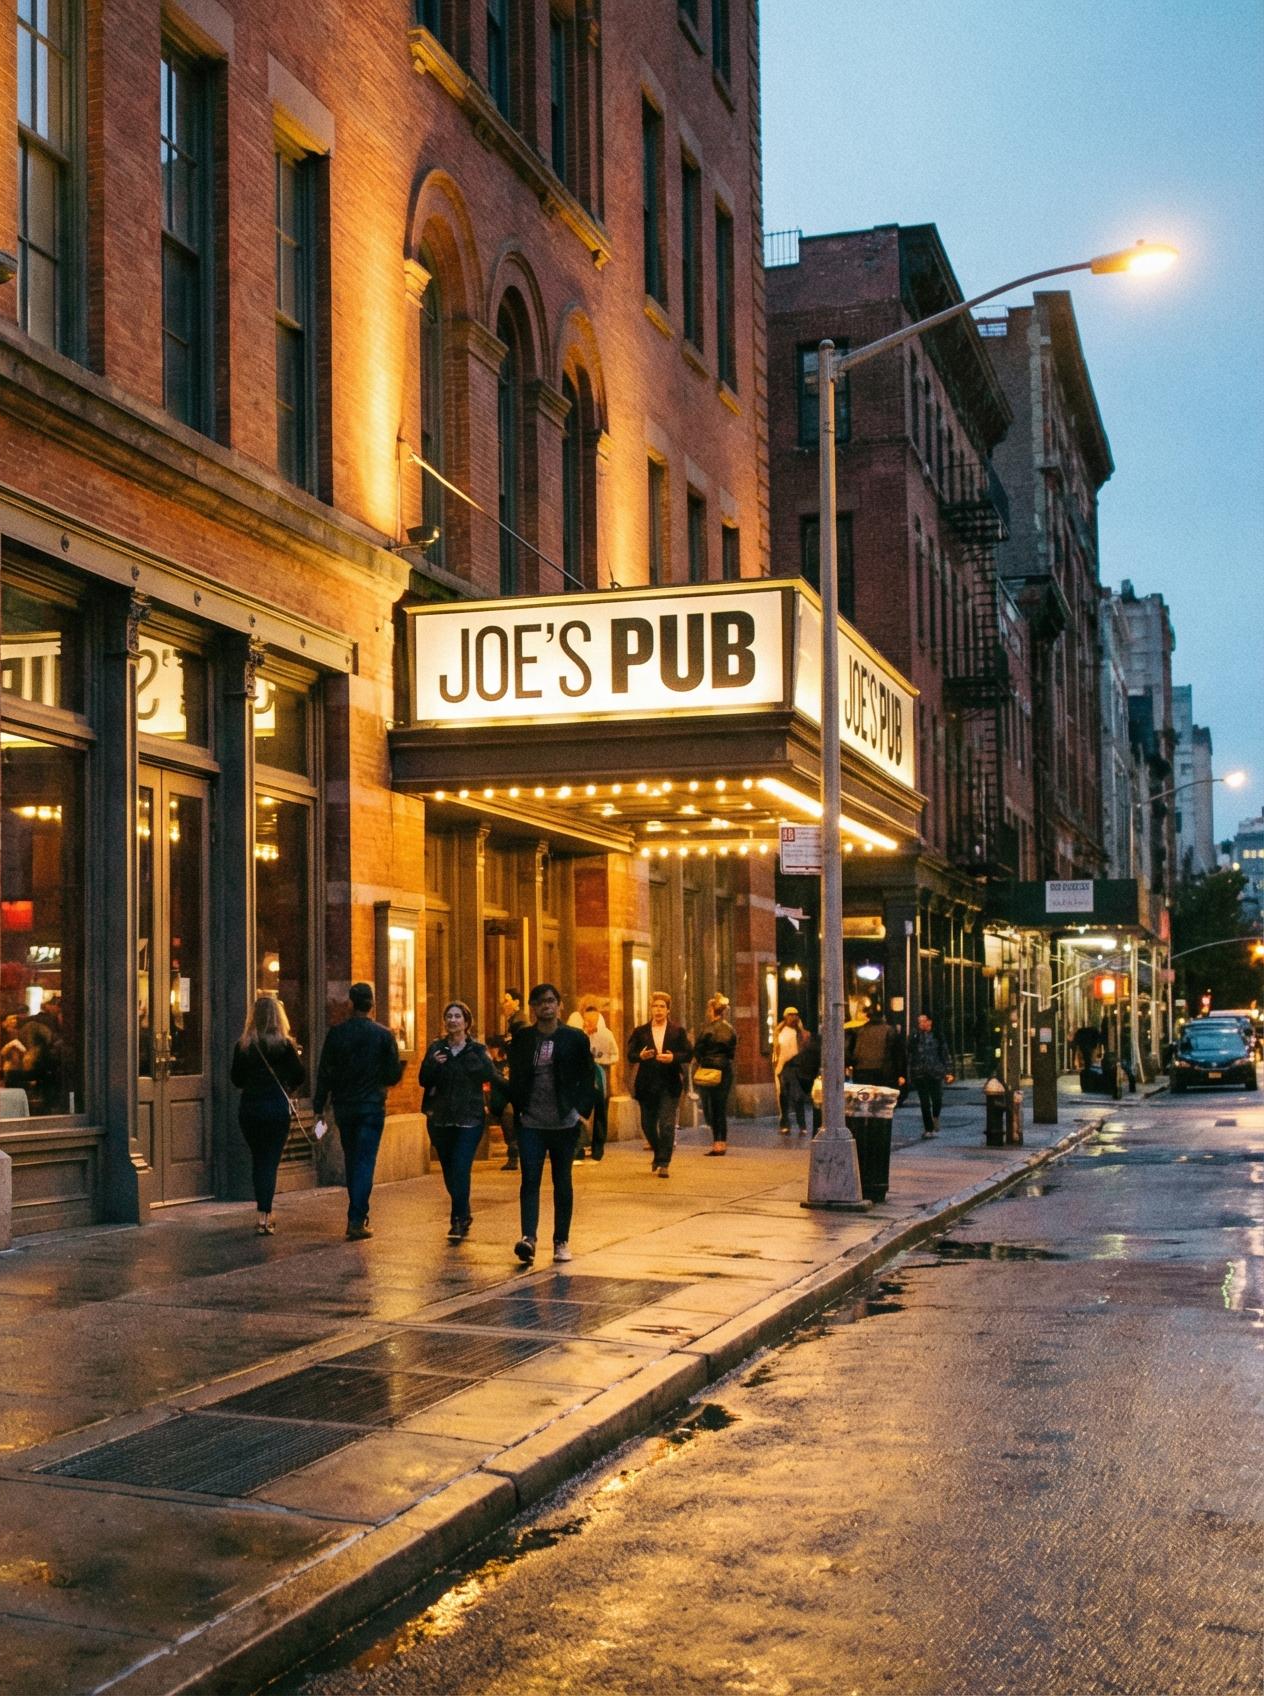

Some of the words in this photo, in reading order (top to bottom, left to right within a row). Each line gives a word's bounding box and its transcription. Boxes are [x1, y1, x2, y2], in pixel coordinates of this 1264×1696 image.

[438, 620, 593, 704] JOE'S
[610, 610, 756, 694] PUB
[844, 653, 878, 749] JOE'S
[879, 682, 903, 766] PUB
